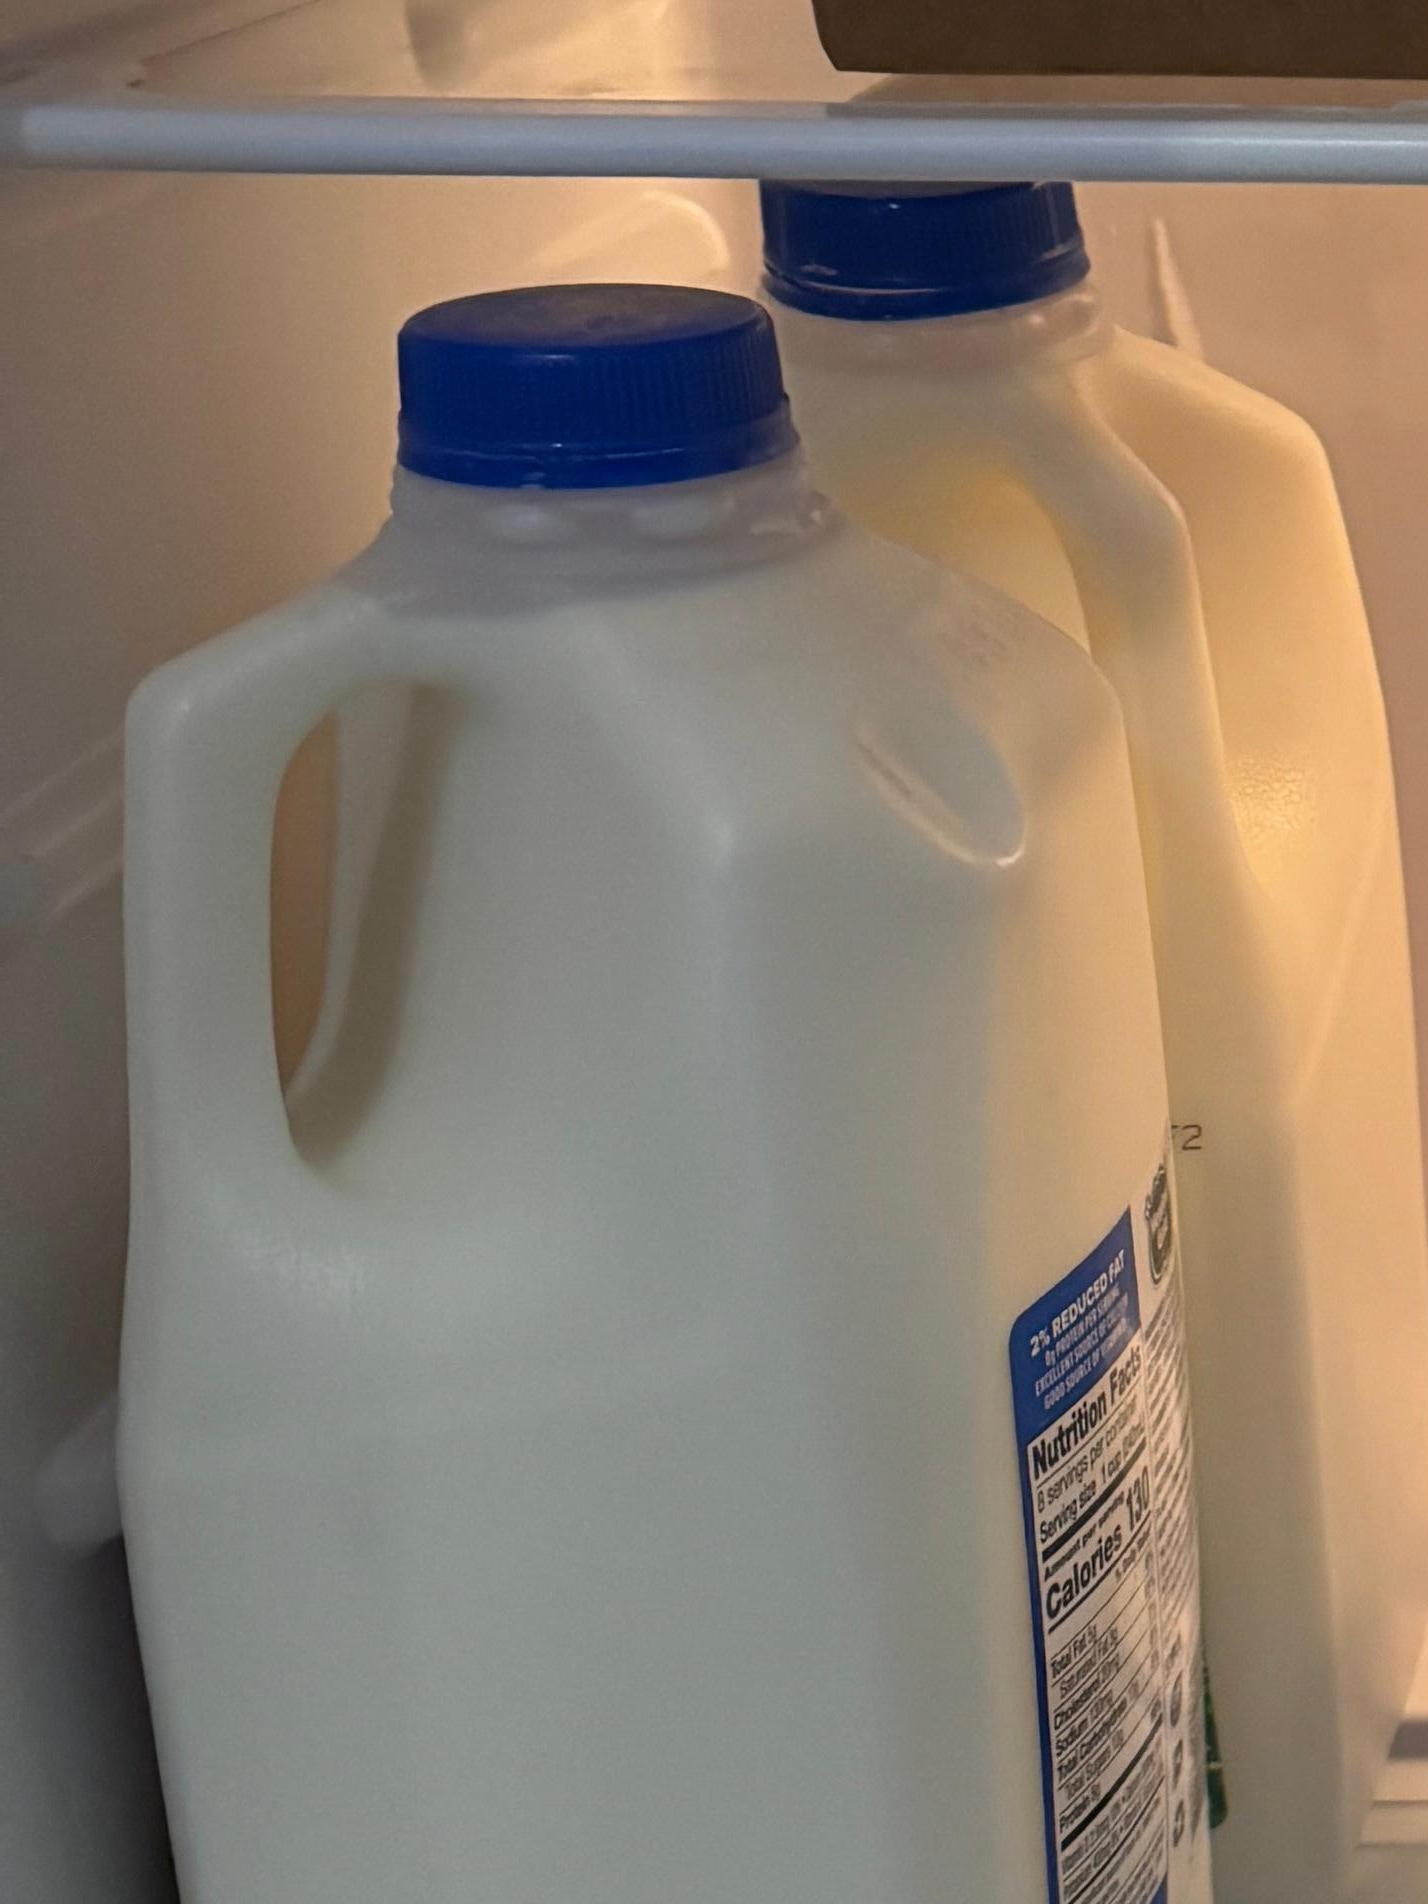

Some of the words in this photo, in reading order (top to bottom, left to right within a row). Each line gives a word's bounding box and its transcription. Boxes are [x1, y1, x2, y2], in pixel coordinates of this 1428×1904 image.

[1030, 1328, 1050, 1357] 2%
[1051, 1273, 1108, 1338] REDUCED
[1109, 1249, 1124, 1283] FAT
[1032, 1389, 1108, 1480] Nutrition
[1109, 1346, 1141, 1405] Facts
[1040, 1504, 1078, 1542] Serving
[1047, 1524, 1122, 1619] Calories
[1126, 1466, 1150, 1532] 130
